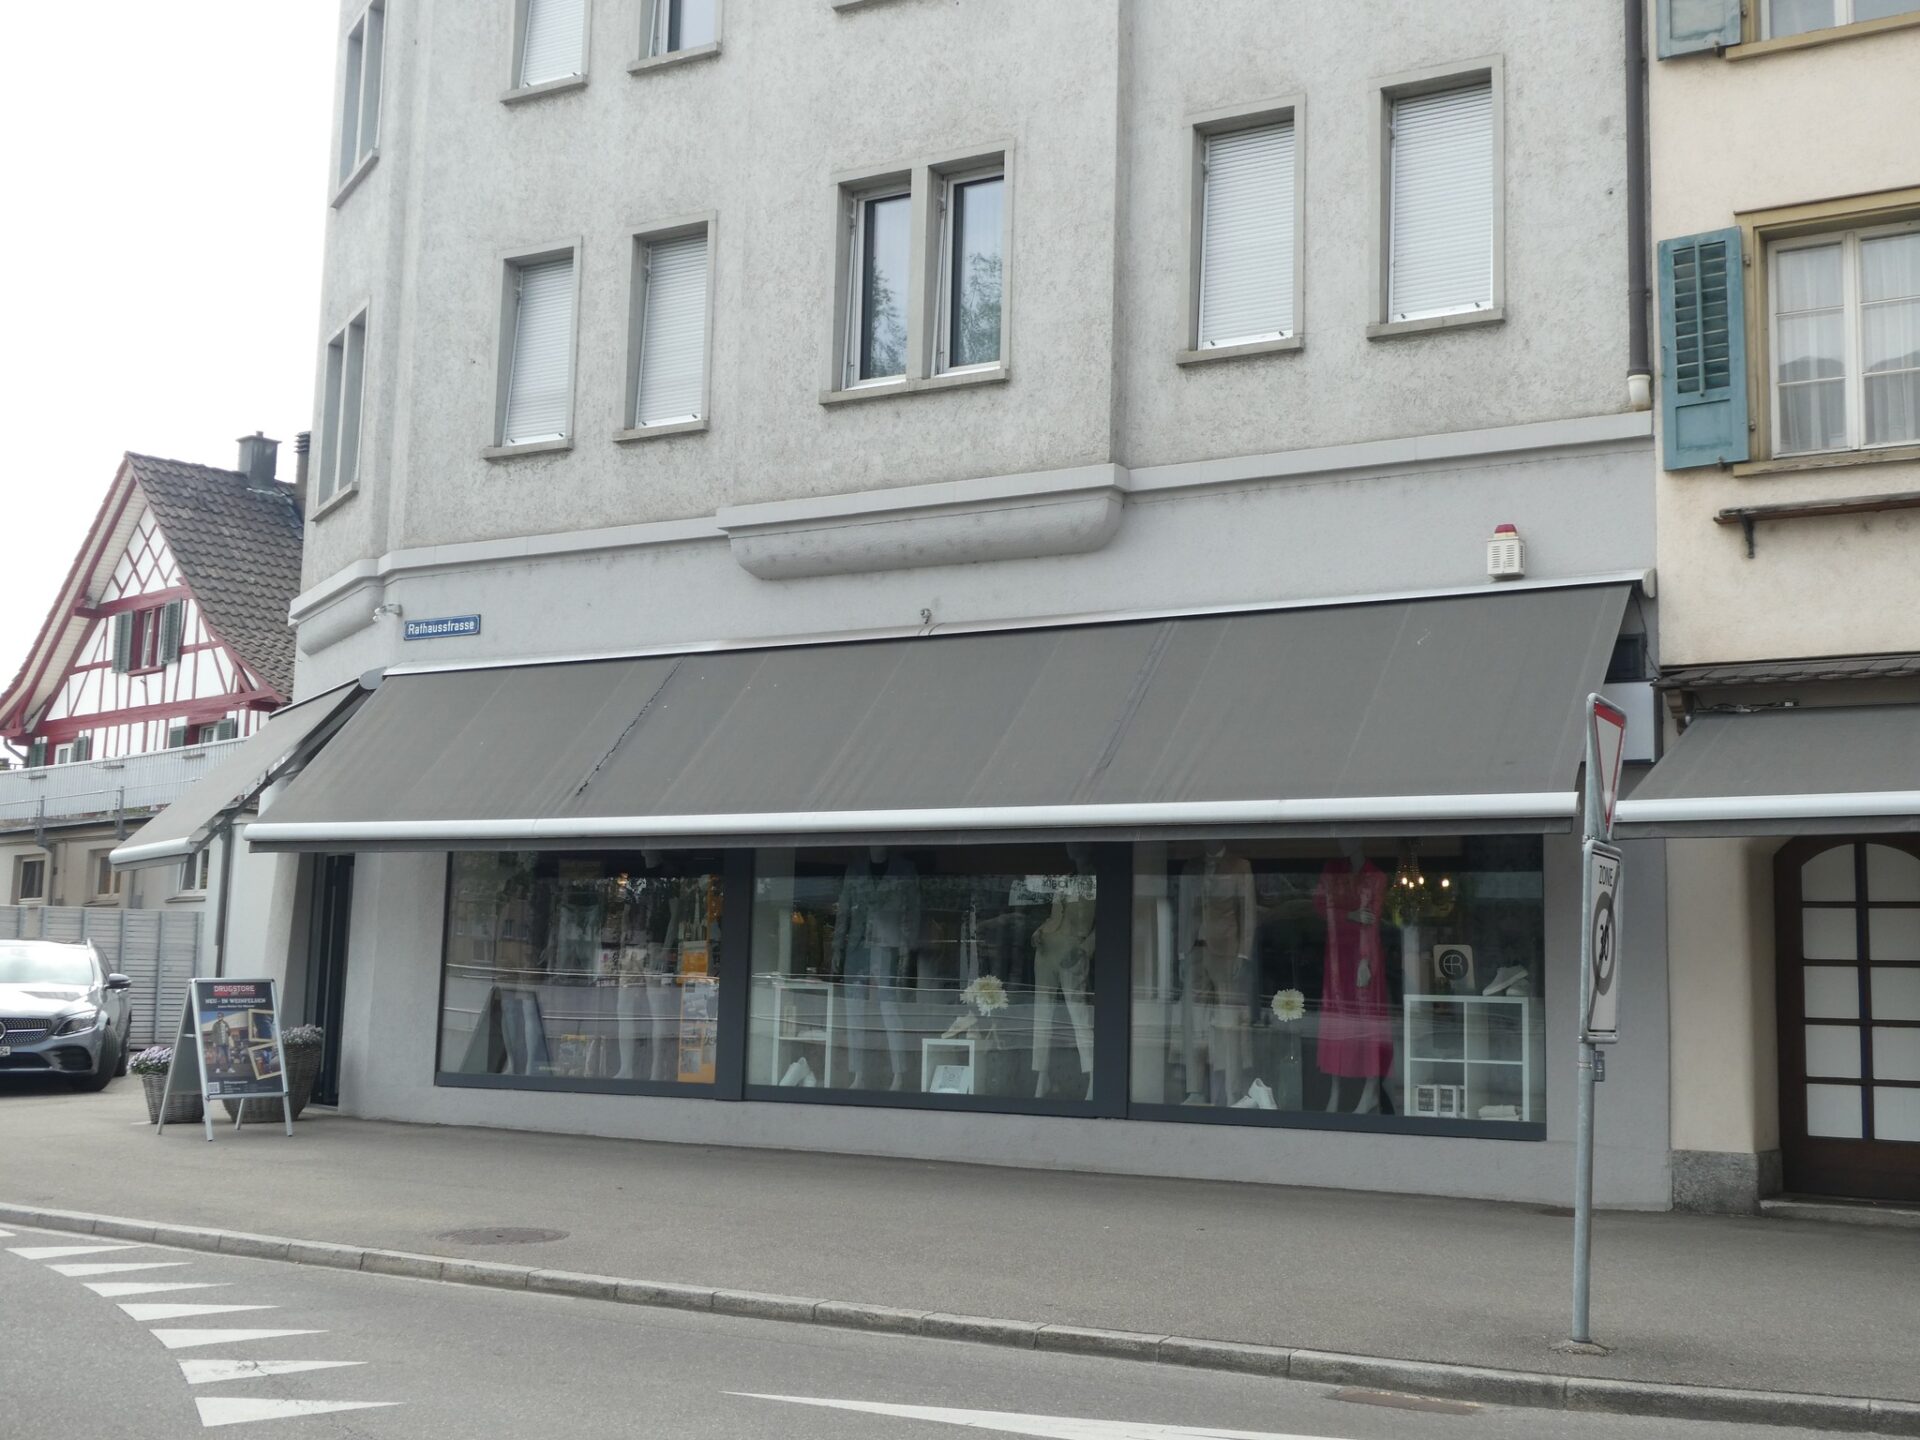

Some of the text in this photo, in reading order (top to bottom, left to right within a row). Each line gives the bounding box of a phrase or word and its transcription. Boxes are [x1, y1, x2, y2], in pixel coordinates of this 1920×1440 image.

[408, 620, 475, 635] Rathausstrasse
[1599, 865, 1613, 887] ZONE
[1599, 924, 1610, 961] 30
